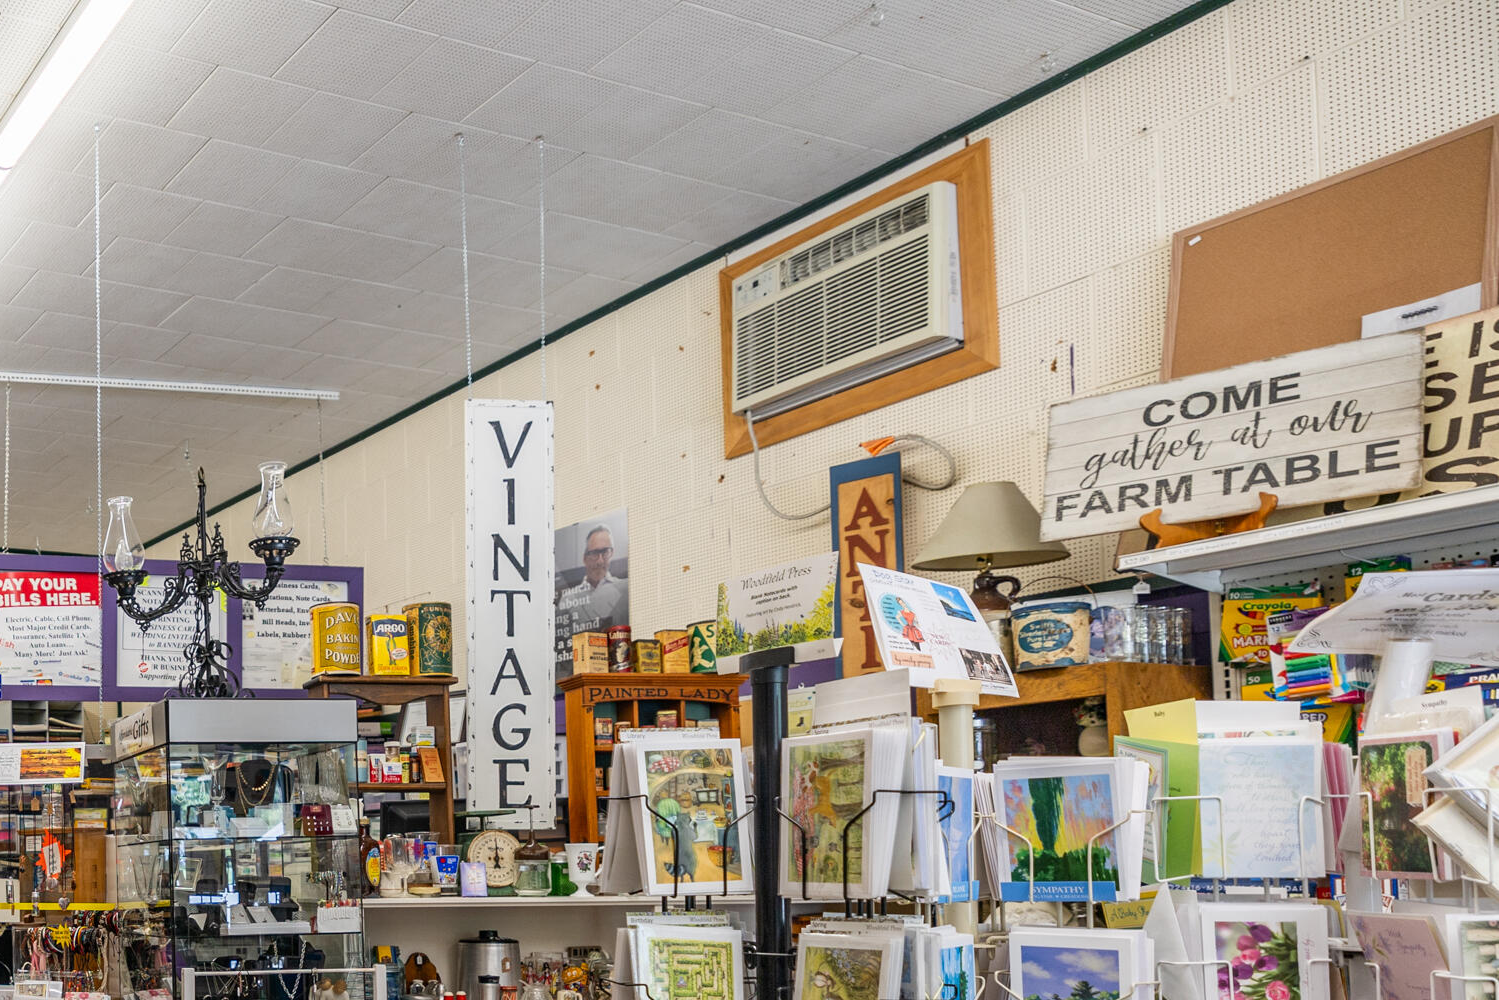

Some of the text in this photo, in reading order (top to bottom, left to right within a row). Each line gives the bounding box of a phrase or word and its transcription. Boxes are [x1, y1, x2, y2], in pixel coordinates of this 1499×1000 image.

[1143, 371, 1301, 428] COME
[1084, 397, 1373, 490] gather at our
[1055, 439, 1401, 522] FARM TABLE
[1351, 567, 1363, 577] 12
[740, 566, 813, 591] Woodfield Press
[29, 577, 77, 591] YOUR
[299, 582, 321, 590] Cards,
[561, 582, 591, 597] much
[46, 592, 96, 606] HERE.
[1229, 591, 1241, 600] 10
[1242, 601, 1293, 612] Crayola
[488, 419, 534, 809] VINTAGE
[275, 619, 298, 627] Heads,
[375, 622, 405, 633] ARGO
[573, 618, 600, 634] hand
[131, 631, 167, 639] WEDDING
[256, 631, 307, 639] Labels, Rubber
[14, 651, 33, 659] Many
[140, 654, 166, 662] THANK
[1257, 649, 1268, 658] 10
[1247, 675, 1261, 684] 50
[588, 687, 735, 702] PAINTED LADY
[1420, 699, 1448, 708] Sympathy
[1032, 885, 1085, 894] SYMPATHY
[630, 917, 653, 925] Birthday
[812, 921, 827, 930] Spring
